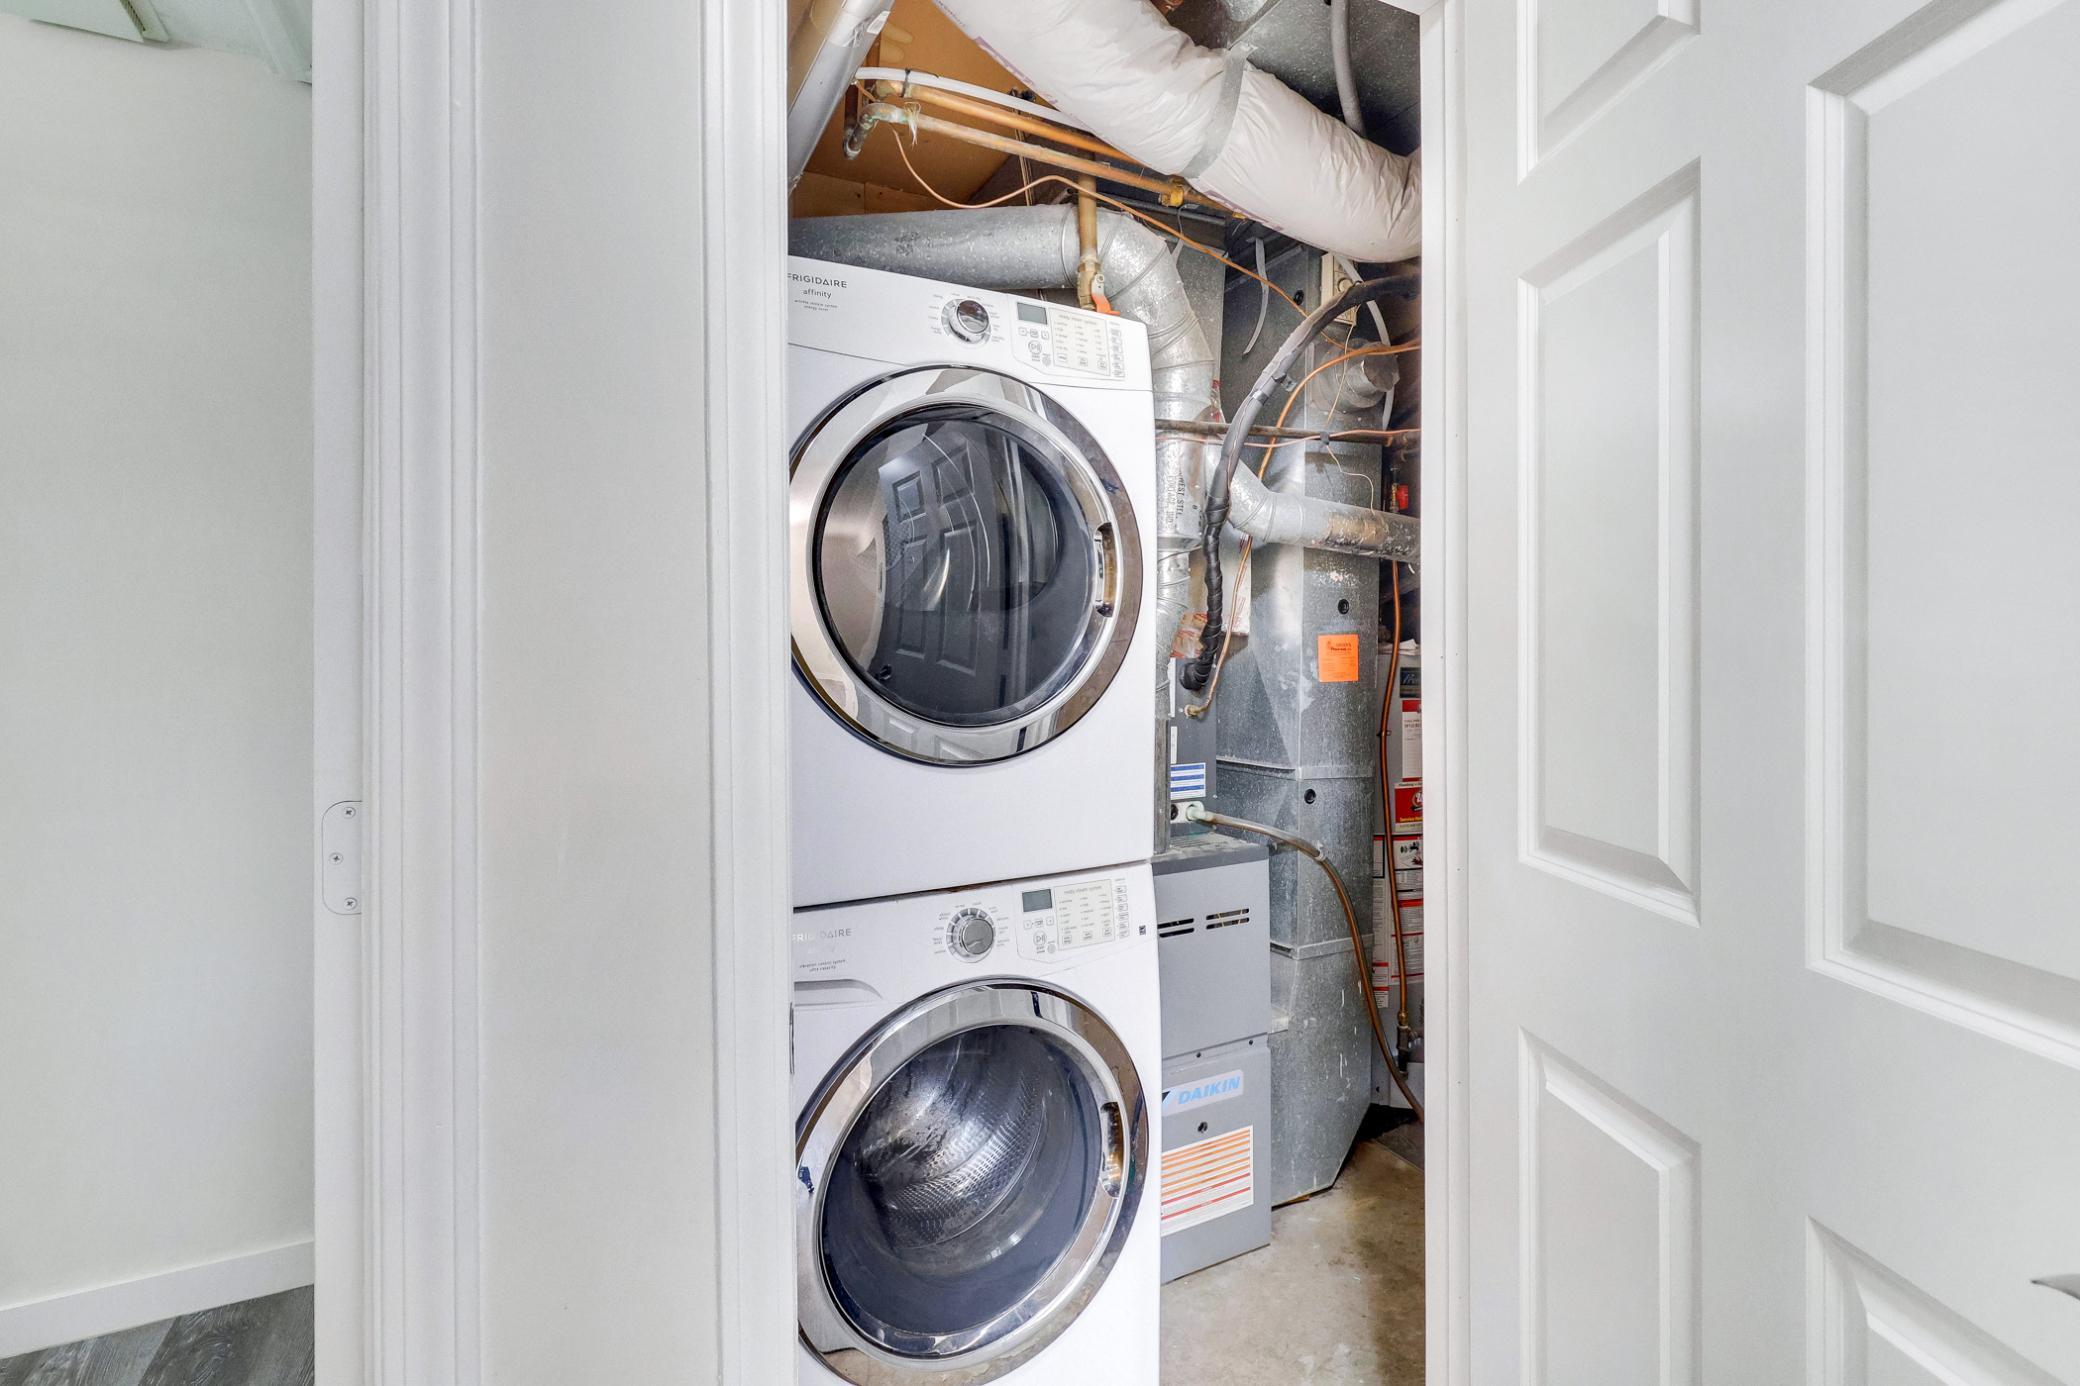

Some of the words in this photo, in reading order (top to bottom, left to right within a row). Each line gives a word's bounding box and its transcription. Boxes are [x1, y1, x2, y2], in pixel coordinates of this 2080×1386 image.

[787, 272, 848, 289] FRIGIDAIRE
[803, 288, 832, 299] affinity
[791, 928, 852, 941] FRIDAIRE
[1178, 1076, 1240, 1105] DAIKIN
